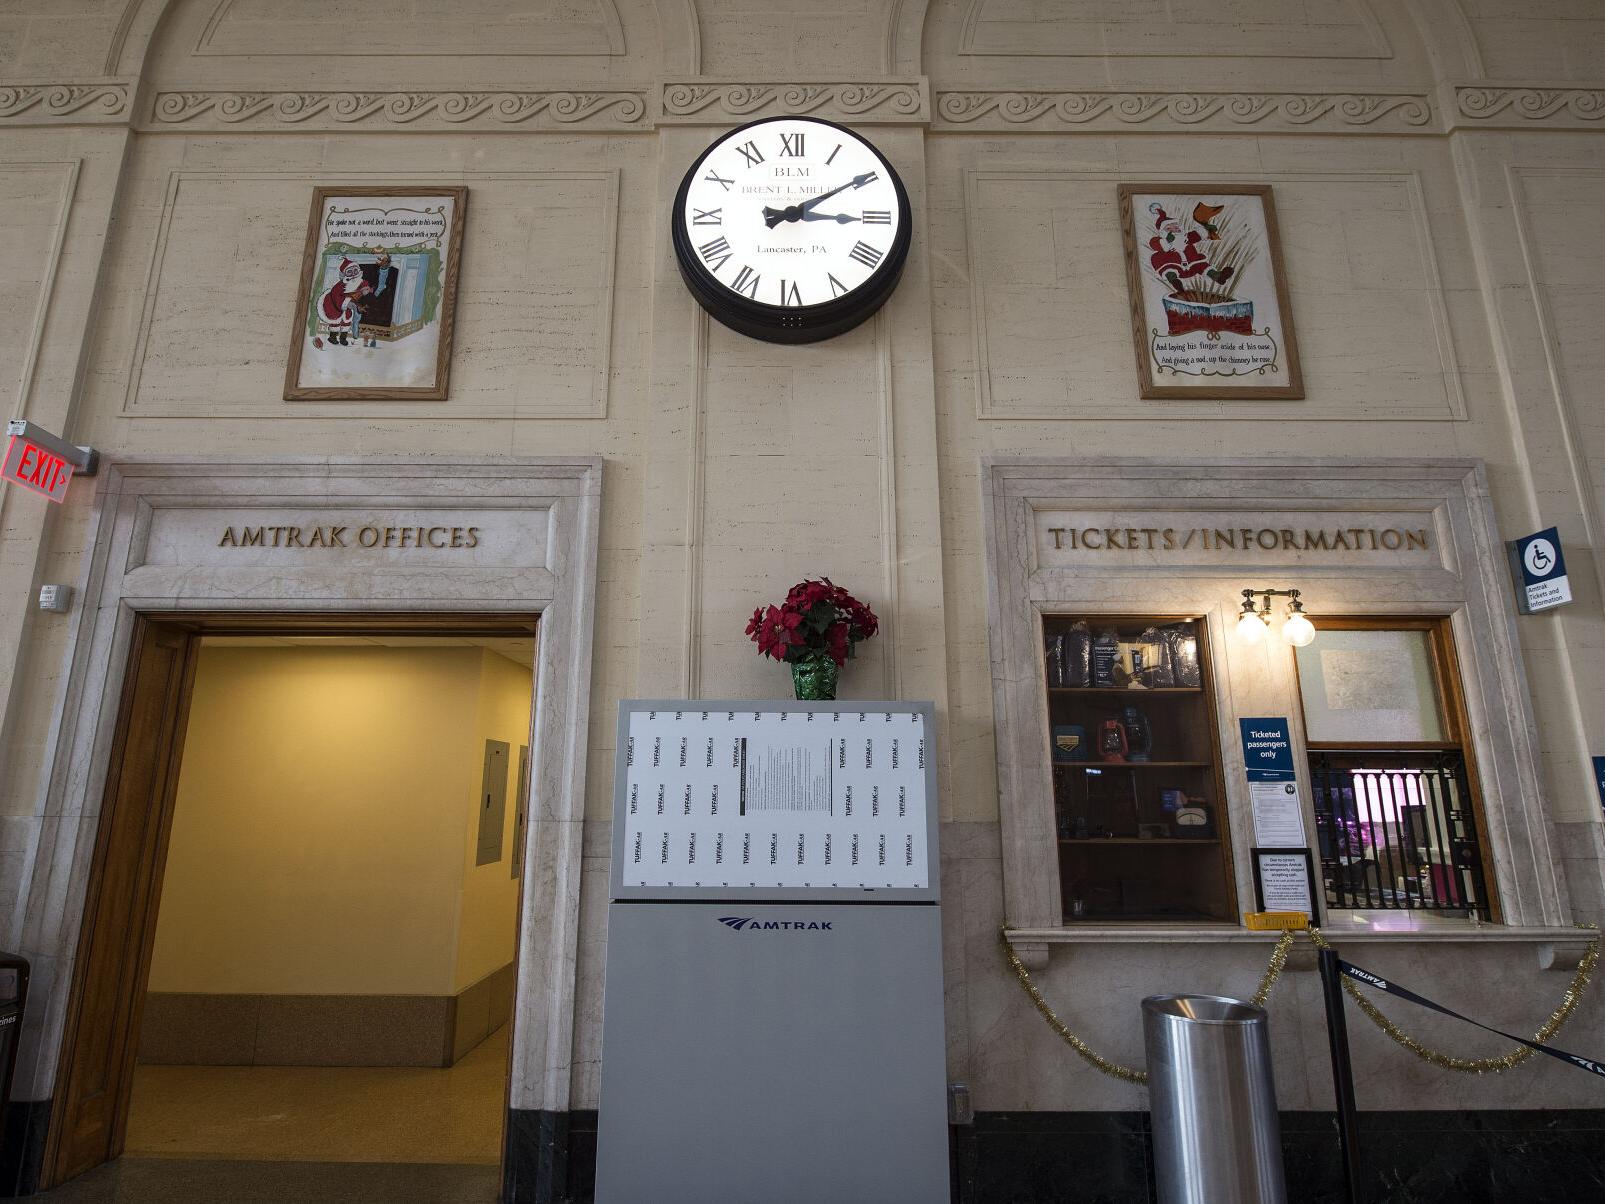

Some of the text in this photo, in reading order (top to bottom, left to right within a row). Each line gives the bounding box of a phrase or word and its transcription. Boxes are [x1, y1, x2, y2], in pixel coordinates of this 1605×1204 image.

[780, 133, 805, 157] XII
[735, 141, 765, 168] XI
[775, 168, 810, 177] BLM
[704, 169, 736, 192] X
[742, 186, 781, 194] BRENT
[693, 208, 722, 226] IX
[862, 210, 891, 225] III
[698, 236, 734, 273] VIII
[757, 245, 827, 254] Lancaster, PA
[849, 240, 883, 270] IIII
[730, 265, 761, 300] VII
[828, 272, 849, 298] V
[780, 279, 803, 305] VI
[1168, 343, 1185, 352] laying
[1200, 342, 1218, 350] finger
[1246, 342, 1256, 350] his
[1228, 356, 1251, 365] chimney
[16, 443, 65, 492] EXIT
[217, 526, 479, 548] AMTRAK OFFICES
[1527, 583, 1548, 593] Amtrak
[1529, 587, 1560, 600] Tickets and
[1530, 595, 1563, 607] Information
[1247, 740, 1287, 749] passengers
[1260, 751, 1276, 759] only
[749, 921, 832, 931] AMTRAK
[1350, 967, 1380, 982] AMTRAK
